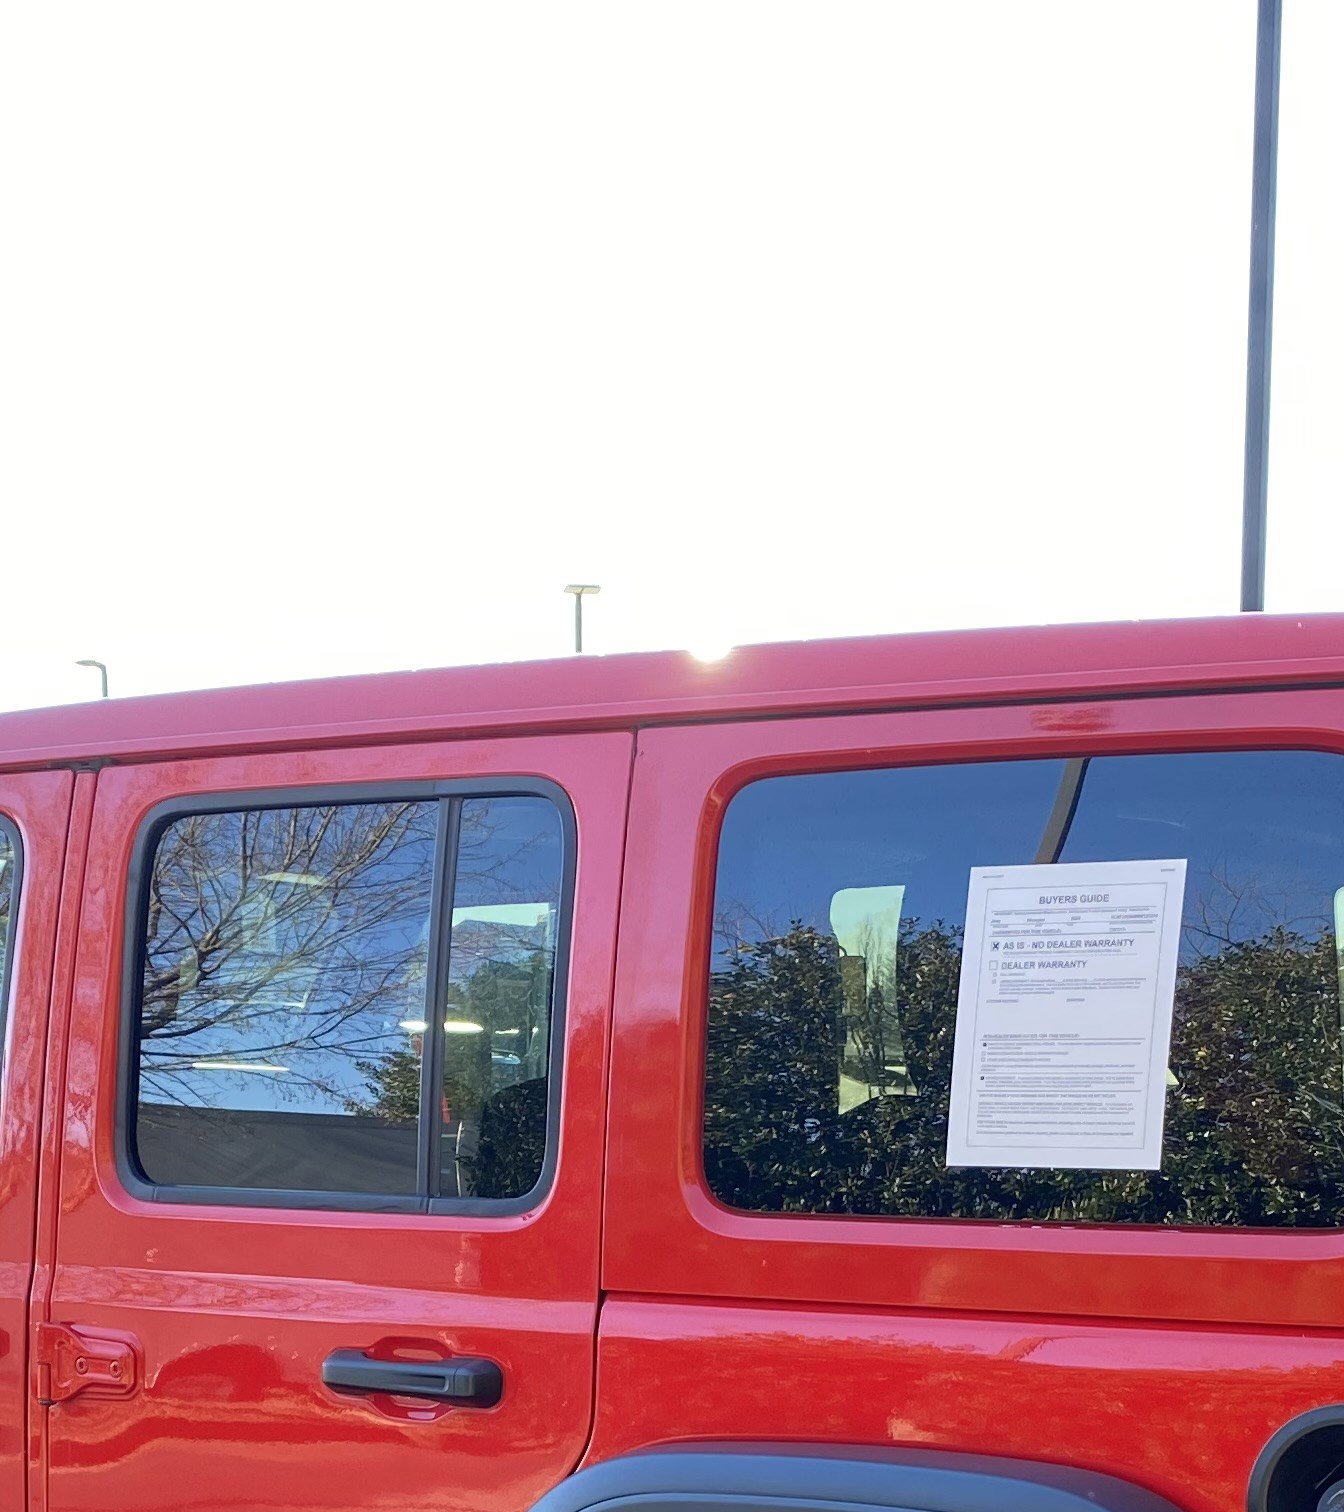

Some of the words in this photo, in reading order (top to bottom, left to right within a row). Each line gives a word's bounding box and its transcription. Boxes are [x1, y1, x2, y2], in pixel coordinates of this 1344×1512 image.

[1038, 895, 1078, 905] BUYERS
[1079, 893, 1110, 904] GUIDE
[1002, 942, 1015, 950] AS
[1016, 941, 1025, 950] IS
[1031, 940, 1046, 949] NO
[1046, 939, 1082, 949] DEALER
[1084, 938, 1134, 948] WARRANTY
[1001, 961, 1036, 970] DEALER
[1037, 960, 1088, 969] WARRANTY
